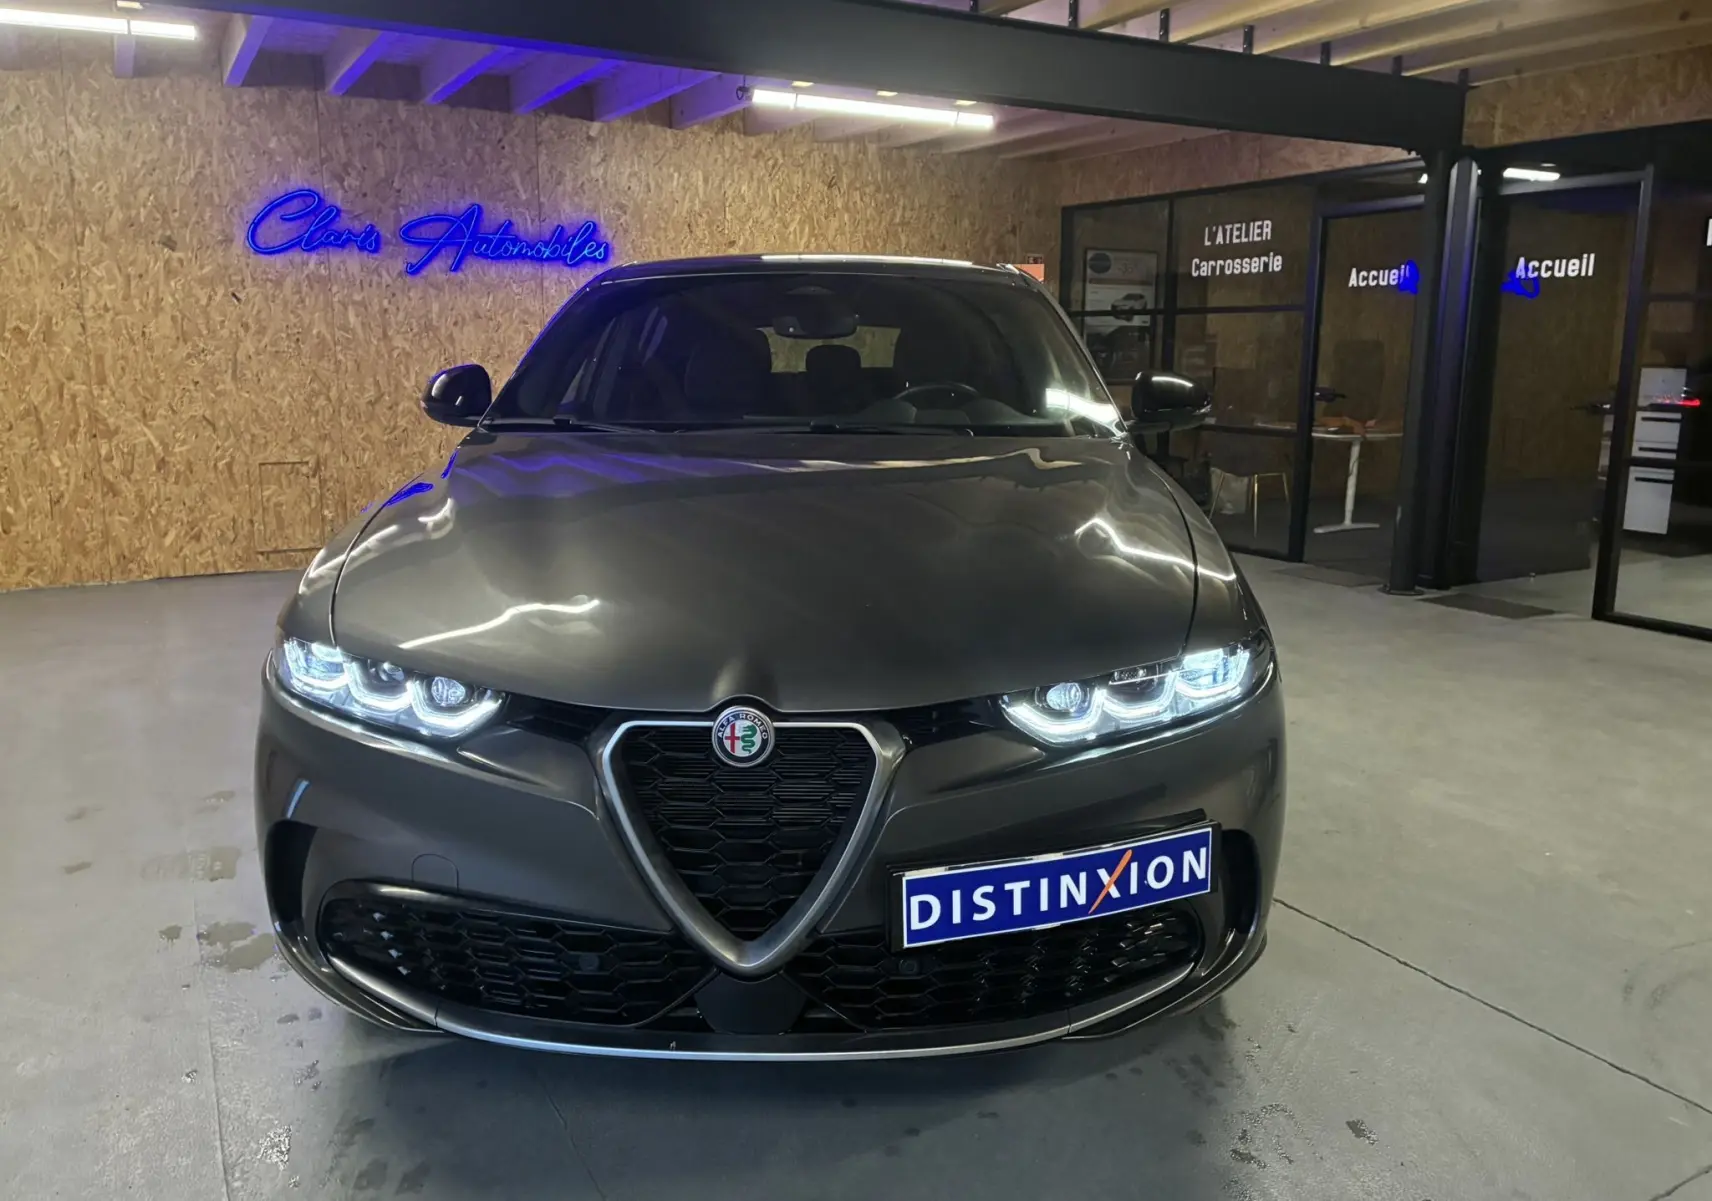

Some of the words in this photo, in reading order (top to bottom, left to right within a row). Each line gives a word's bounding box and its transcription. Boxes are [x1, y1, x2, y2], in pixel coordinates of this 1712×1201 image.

[247, 189, 380, 255] Claris
[400, 204, 610, 275] Automobiles
[1204, 220, 1272, 246] L'ATELIER
[1191, 252, 1283, 277] Carrosserie
[1515, 253, 1595, 279] Accueil
[717, 715, 735, 738] ALFA
[740, 713, 768, 740] ROMEO
[909, 847, 1207, 930] DISTINXION
